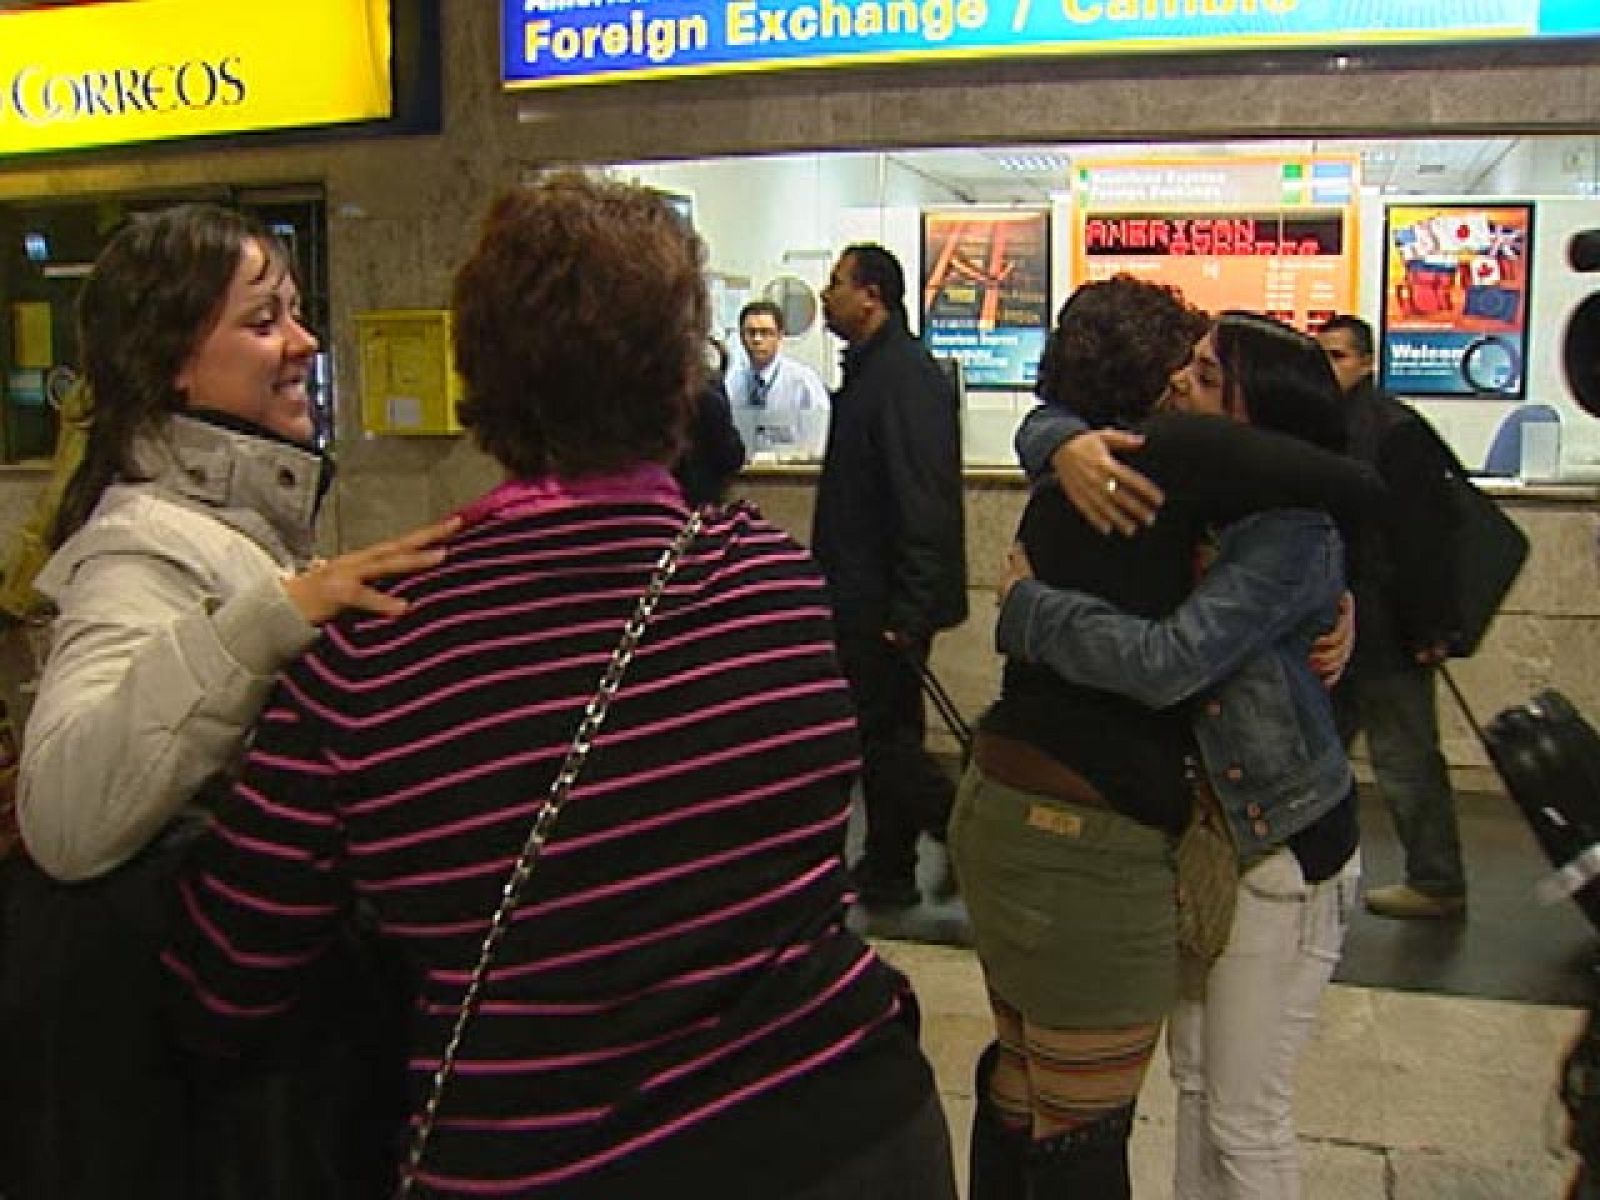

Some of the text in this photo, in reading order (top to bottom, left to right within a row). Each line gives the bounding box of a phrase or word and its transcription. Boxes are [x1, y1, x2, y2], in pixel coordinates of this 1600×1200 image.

[523, 9, 708, 63] Foreign
[725, 0, 988, 46] Exchange
[11, 56, 247, 124] CORREOS
